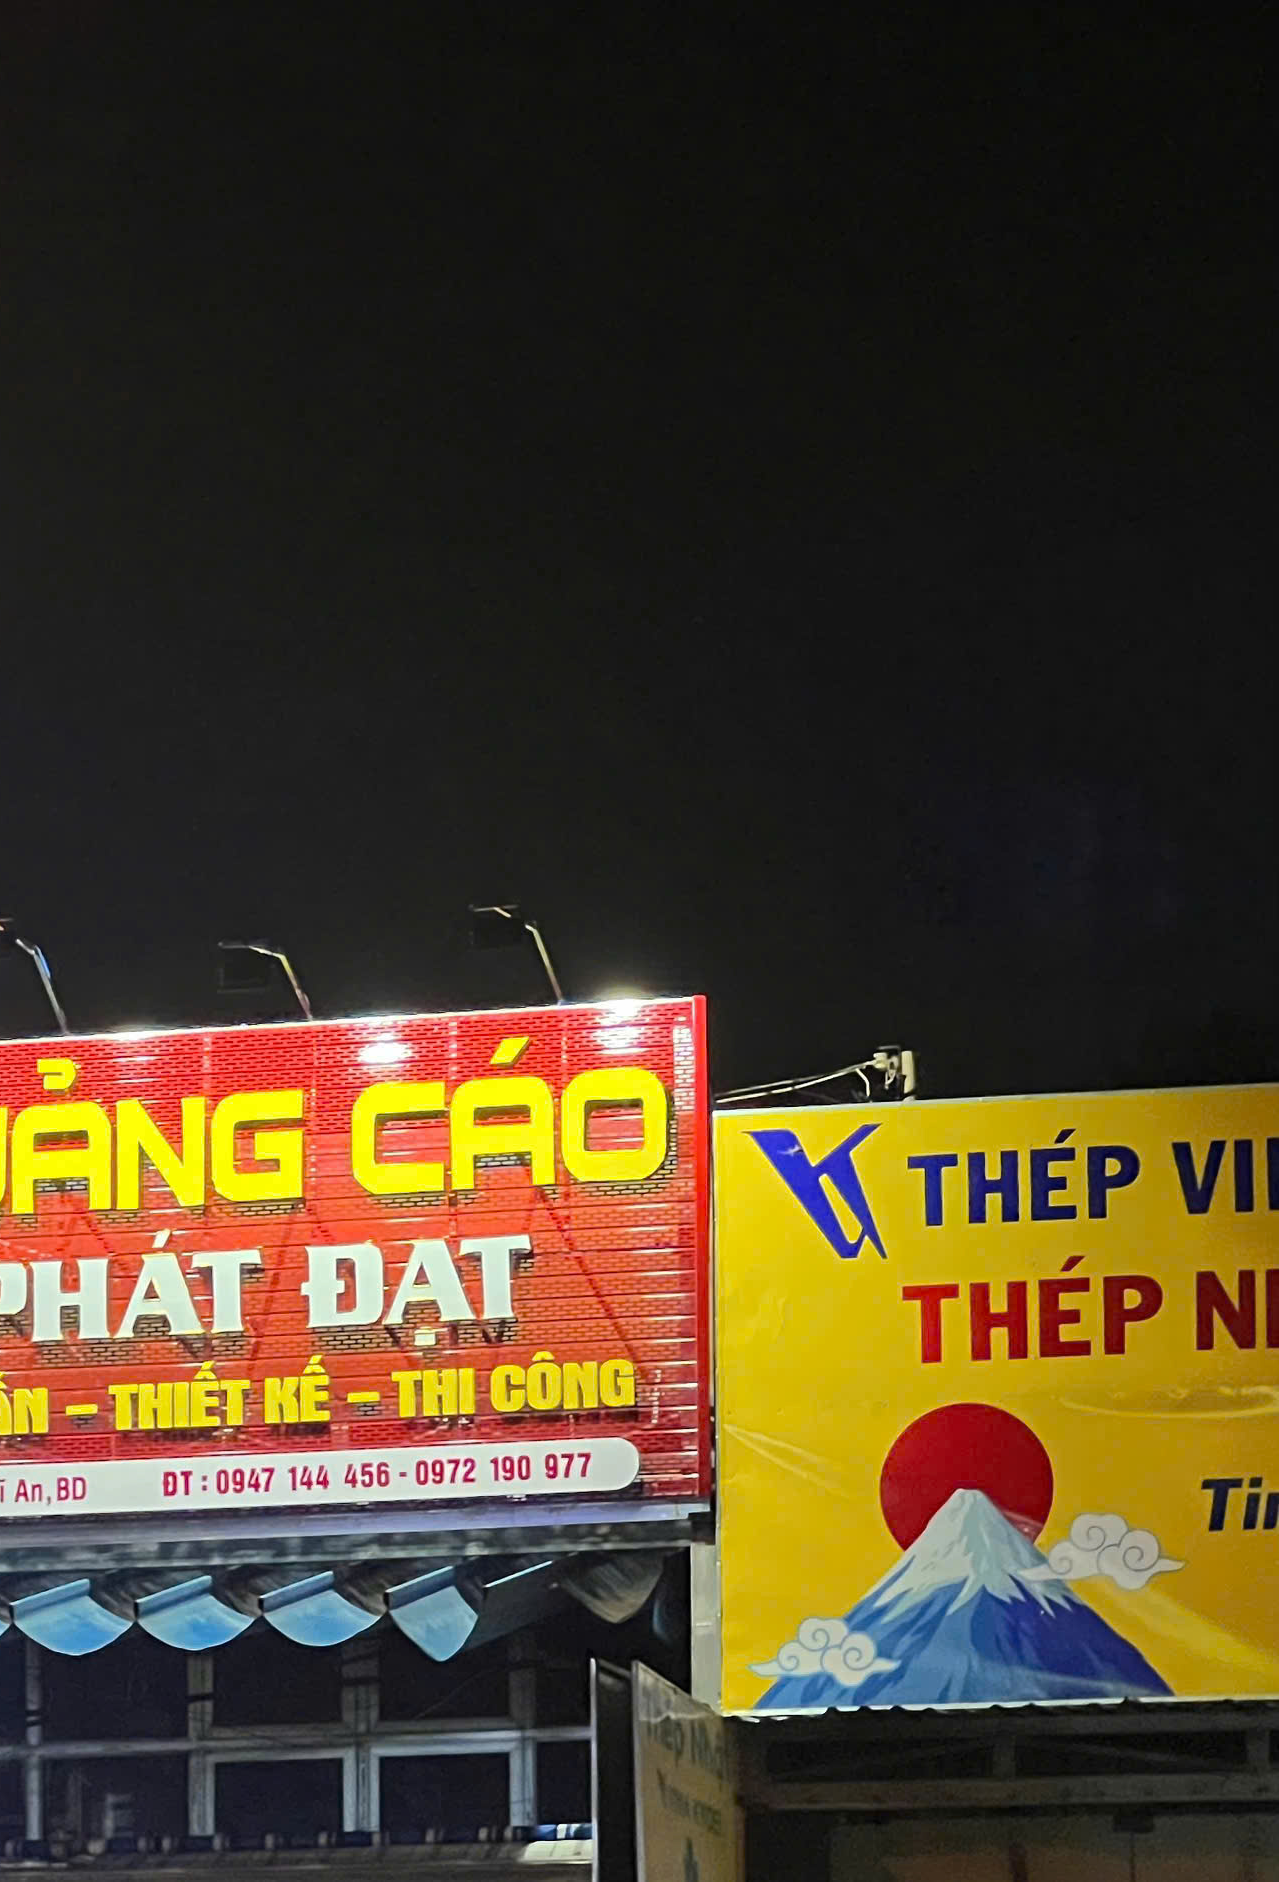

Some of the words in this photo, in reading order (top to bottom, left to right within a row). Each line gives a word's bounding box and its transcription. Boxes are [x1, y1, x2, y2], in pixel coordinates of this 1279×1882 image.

[351, 1036, 670, 1196] CÁO
[907, 1128, 1141, 1227] THÉP
[1171, 1137, 1279, 1215] VI
[301, 1234, 532, 1347] ĐẠT
[902, 1256, 1164, 1364] THÉP
[1196, 1269, 1279, 1351] N
[108, 1360, 251, 1431] THIẾT
[264, 1354, 332, 1424] KẾ
[391, 1367, 476, 1418] THI
[490, 1350, 637, 1413] CÔNG
[216, 1466, 276, 1495] 0947
[289, 1465, 330, 1491] 144
[344, 1461, 390, 1489] 456
[415, 1457, 476, 1486] 0972
[491, 1454, 531, 1483] 190
[545, 1452, 592, 1480] 977
[1201, 1477, 1279, 1532] Ti
